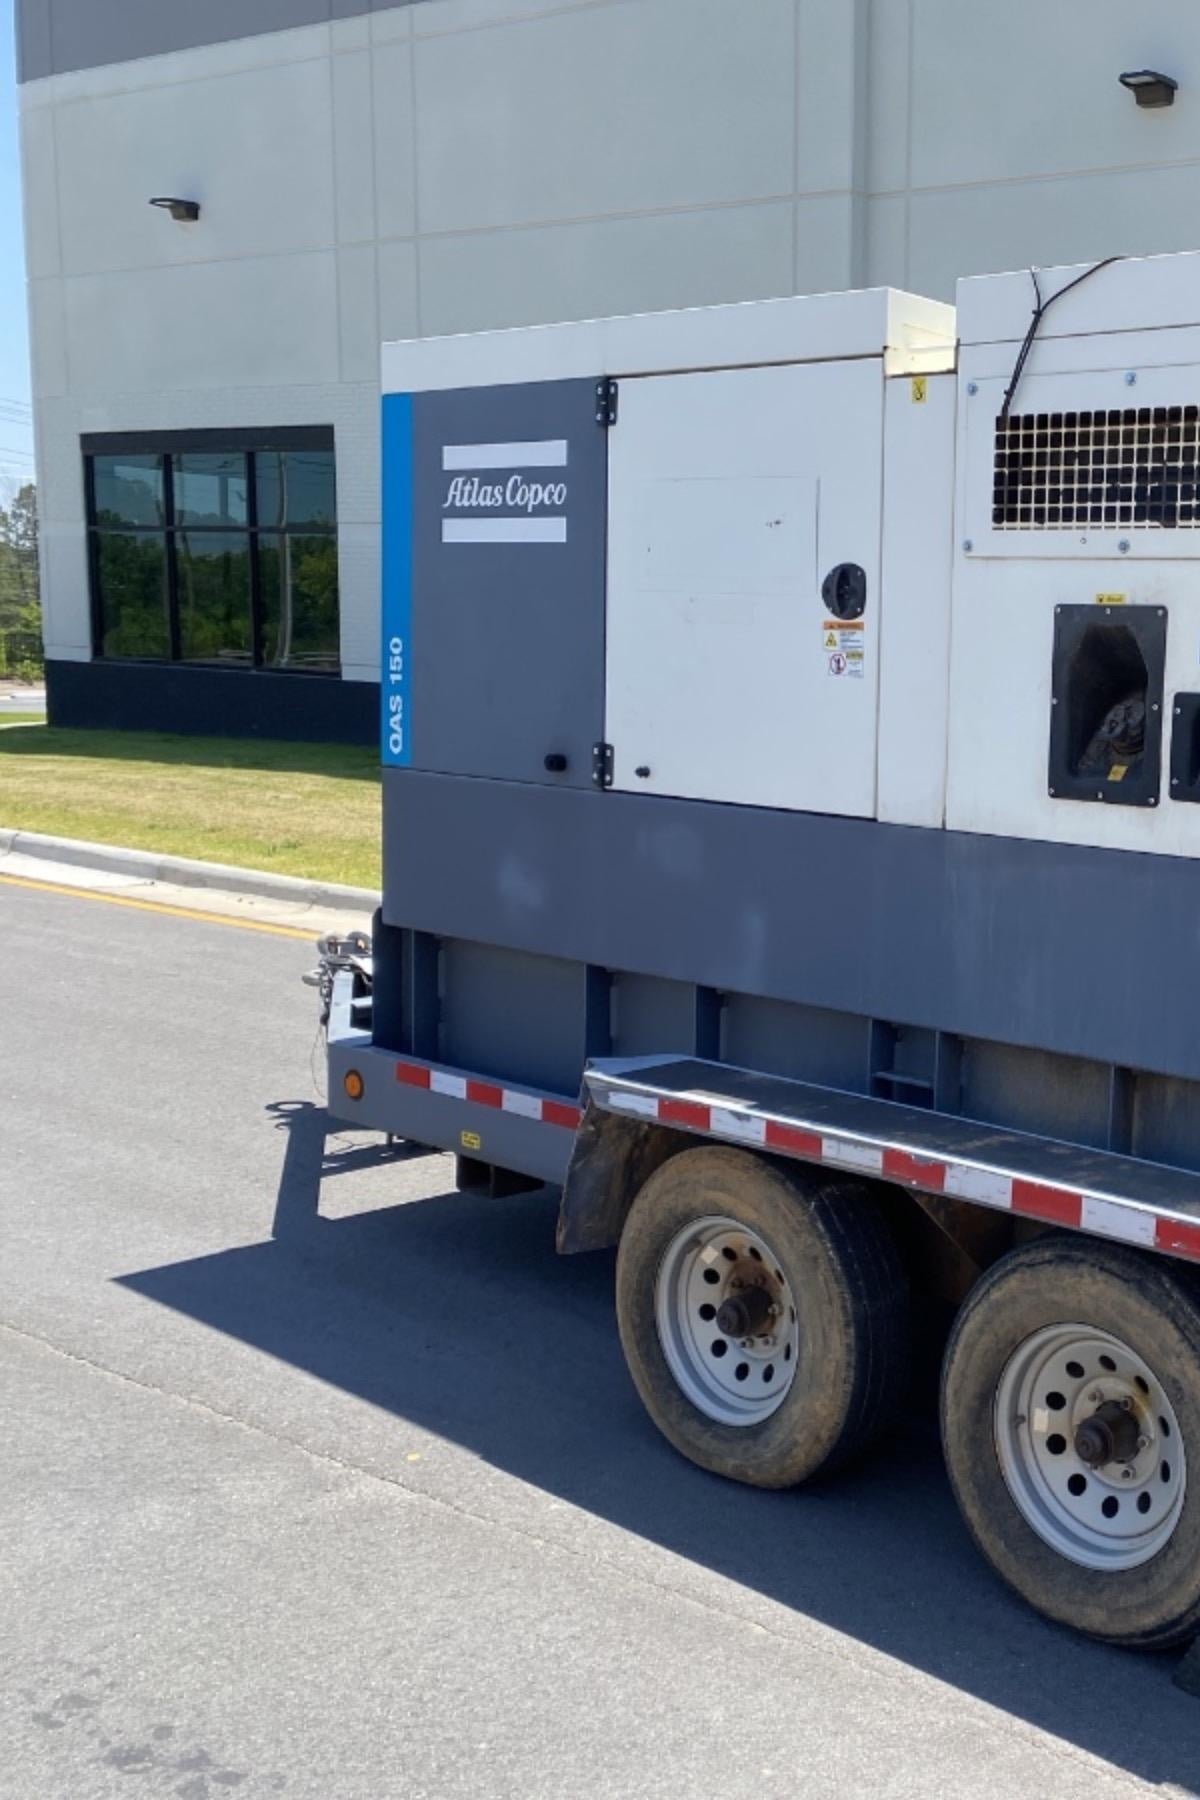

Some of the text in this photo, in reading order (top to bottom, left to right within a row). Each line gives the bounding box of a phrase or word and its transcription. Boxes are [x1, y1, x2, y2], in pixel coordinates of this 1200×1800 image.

[442, 474, 567, 513] Atlas Copco
[388, 636, 405, 755] QAS 150
